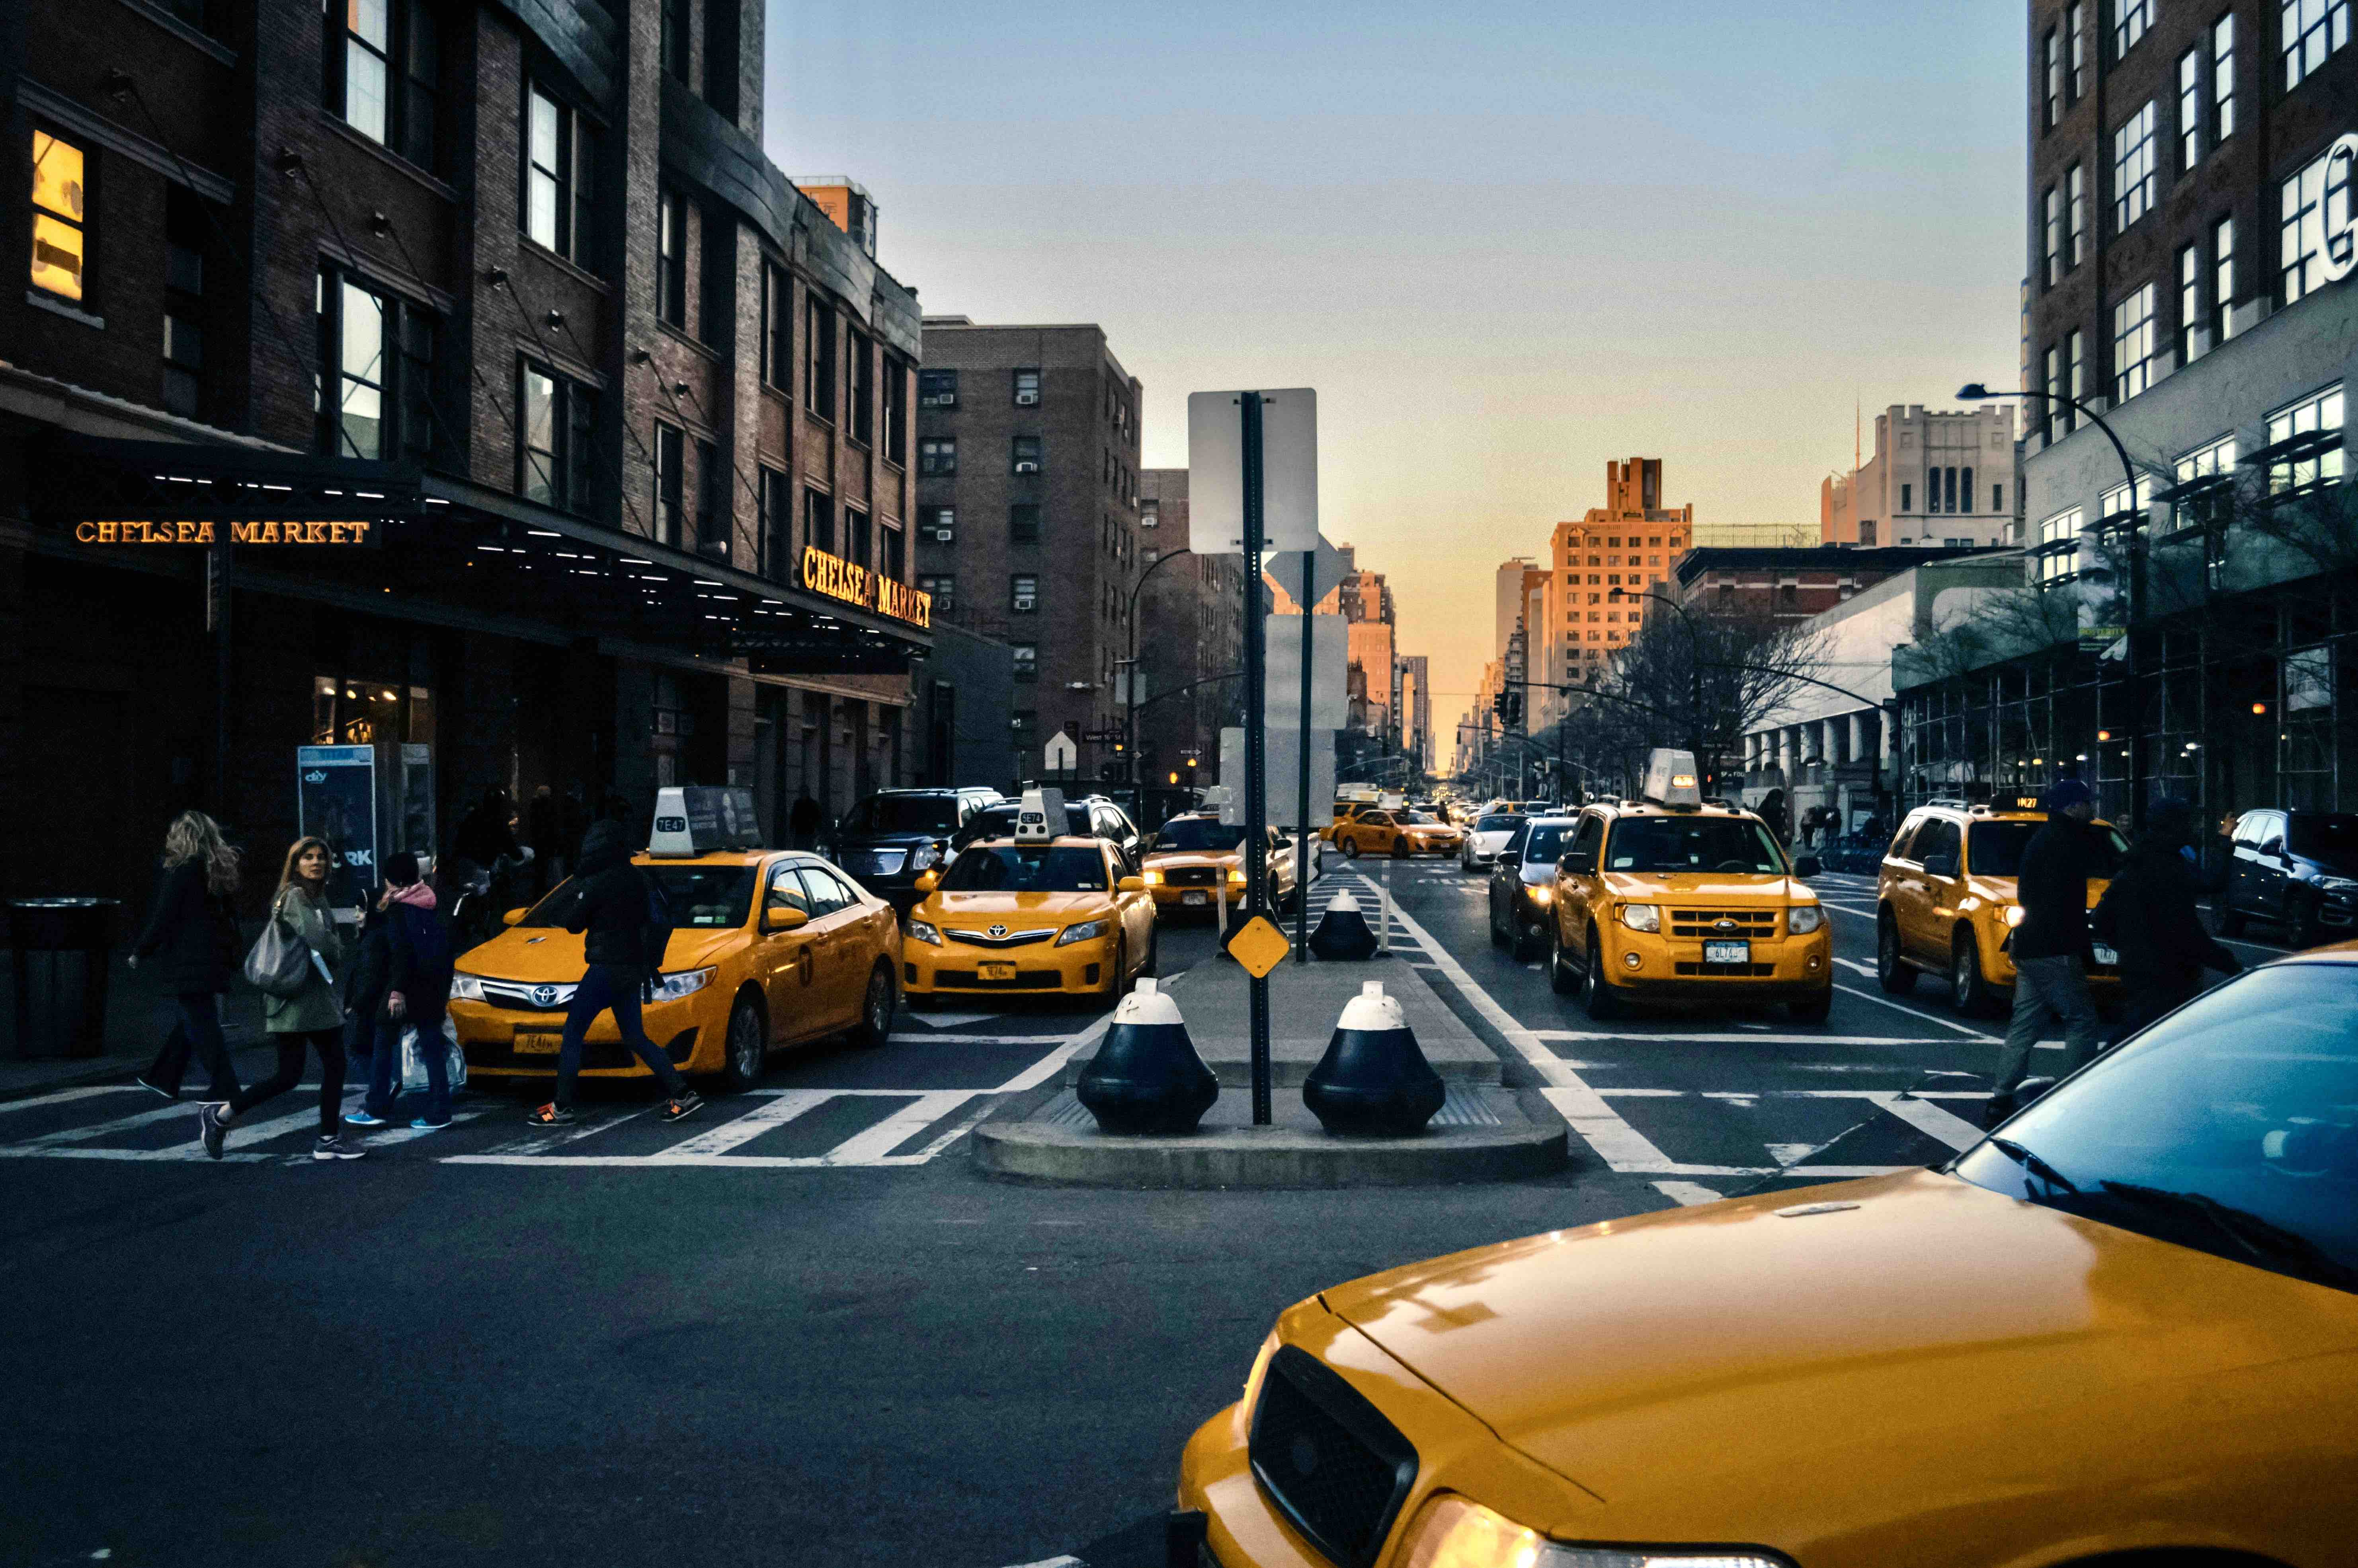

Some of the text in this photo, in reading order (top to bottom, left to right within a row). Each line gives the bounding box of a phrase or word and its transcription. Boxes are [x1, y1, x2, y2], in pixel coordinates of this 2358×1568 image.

[76, 521, 370, 544] CHELSEA MARKET
[803, 545, 932, 629] CHELSEA MARKET
[658, 819, 683, 831] 7E47
